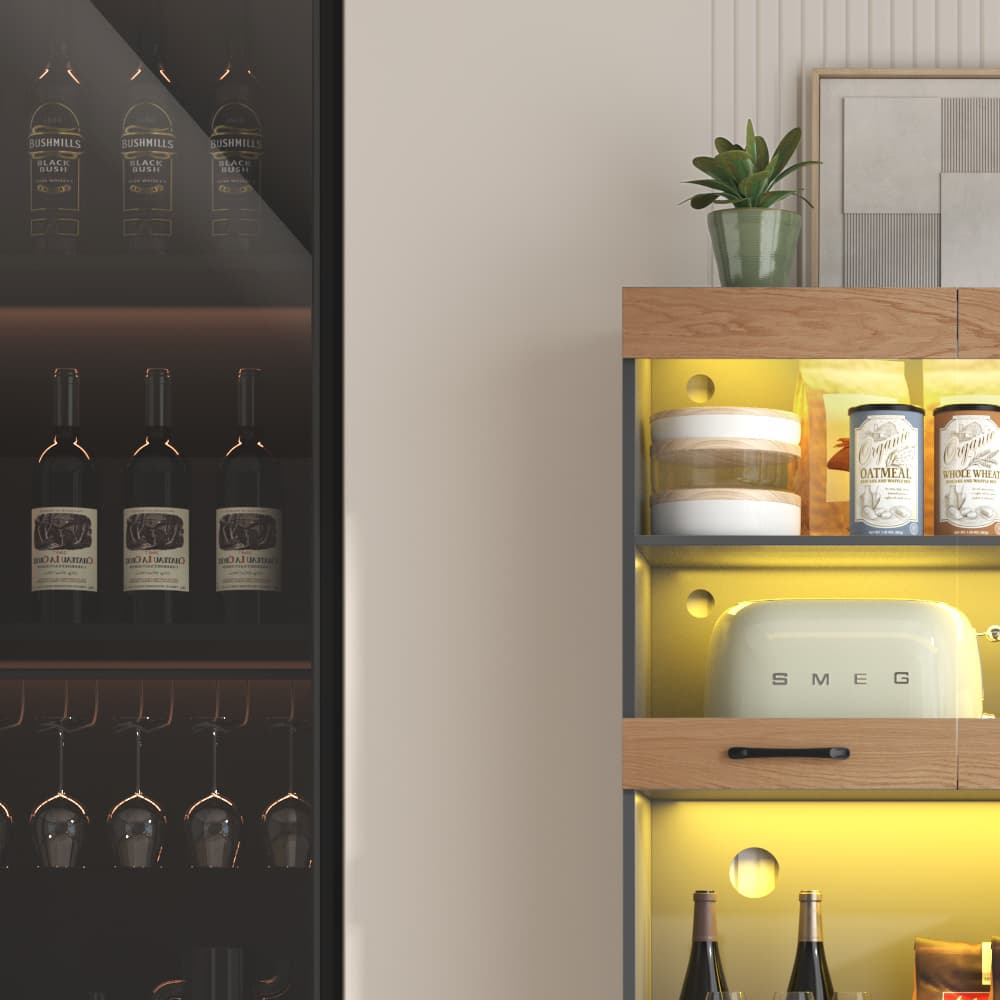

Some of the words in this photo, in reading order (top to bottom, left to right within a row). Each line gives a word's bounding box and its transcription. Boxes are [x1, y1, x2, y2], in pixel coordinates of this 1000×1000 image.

[29, 138, 81, 149] BUSHMILLS
[121, 138, 174, 149] BUSHMILLS
[210, 138, 261, 149] BUSHMILLS
[858, 429, 909, 466] Organic
[943, 429, 994, 466] Organic
[860, 467, 912, 479] OATMEAL
[943, 468, 971, 479] WHOLE
[973, 468, 1000, 479] WHEAT
[772, 671, 909, 686] SMEG
